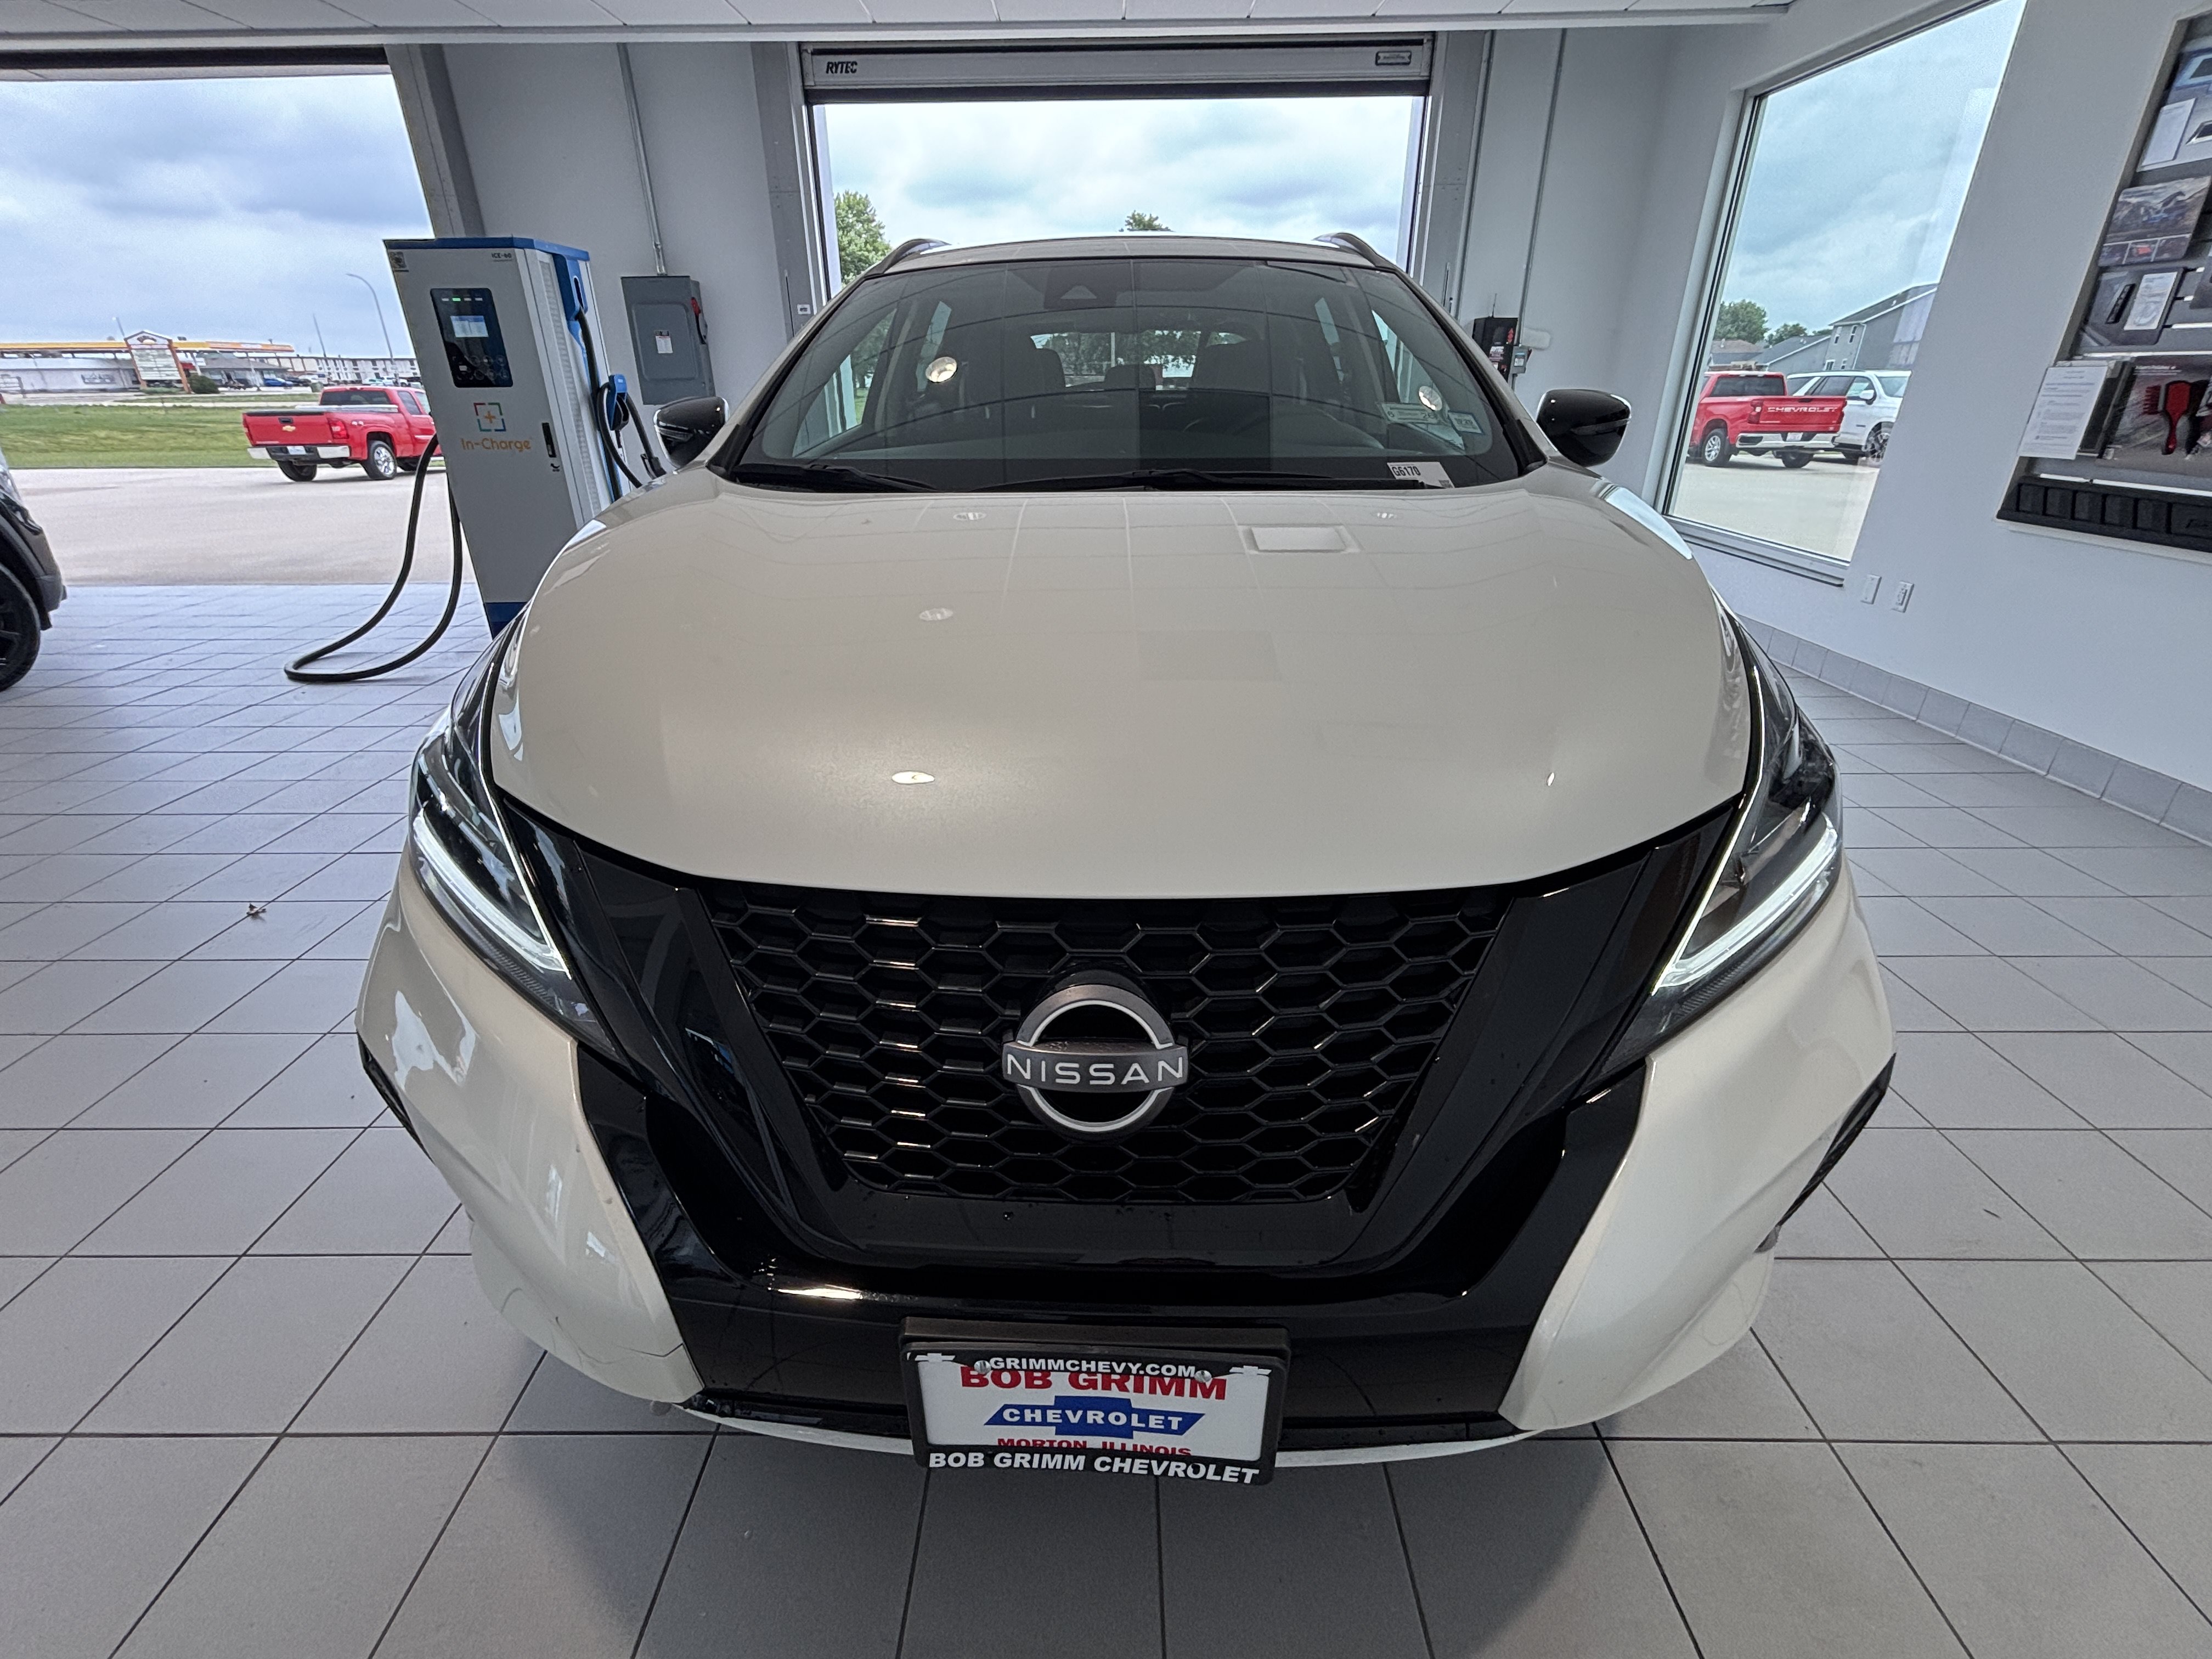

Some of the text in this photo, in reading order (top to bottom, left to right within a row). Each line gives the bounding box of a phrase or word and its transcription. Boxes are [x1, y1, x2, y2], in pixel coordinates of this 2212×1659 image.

[826, 61, 857, 74] RYTEC
[460, 438, 532, 452] In-Charge
[1392, 466, 1421, 476] G6170
[1007, 1053, 1183, 1085] NISSAN
[989, 1357, 1196, 1378] GRIMMCHEVY.COM
[960, 1366, 1227, 1400] BOB GRIMM
[1002, 1408, 1183, 1430] CHEVROLET
[929, 1452, 1260, 1484] BOB GRIMM CHEVROLET
